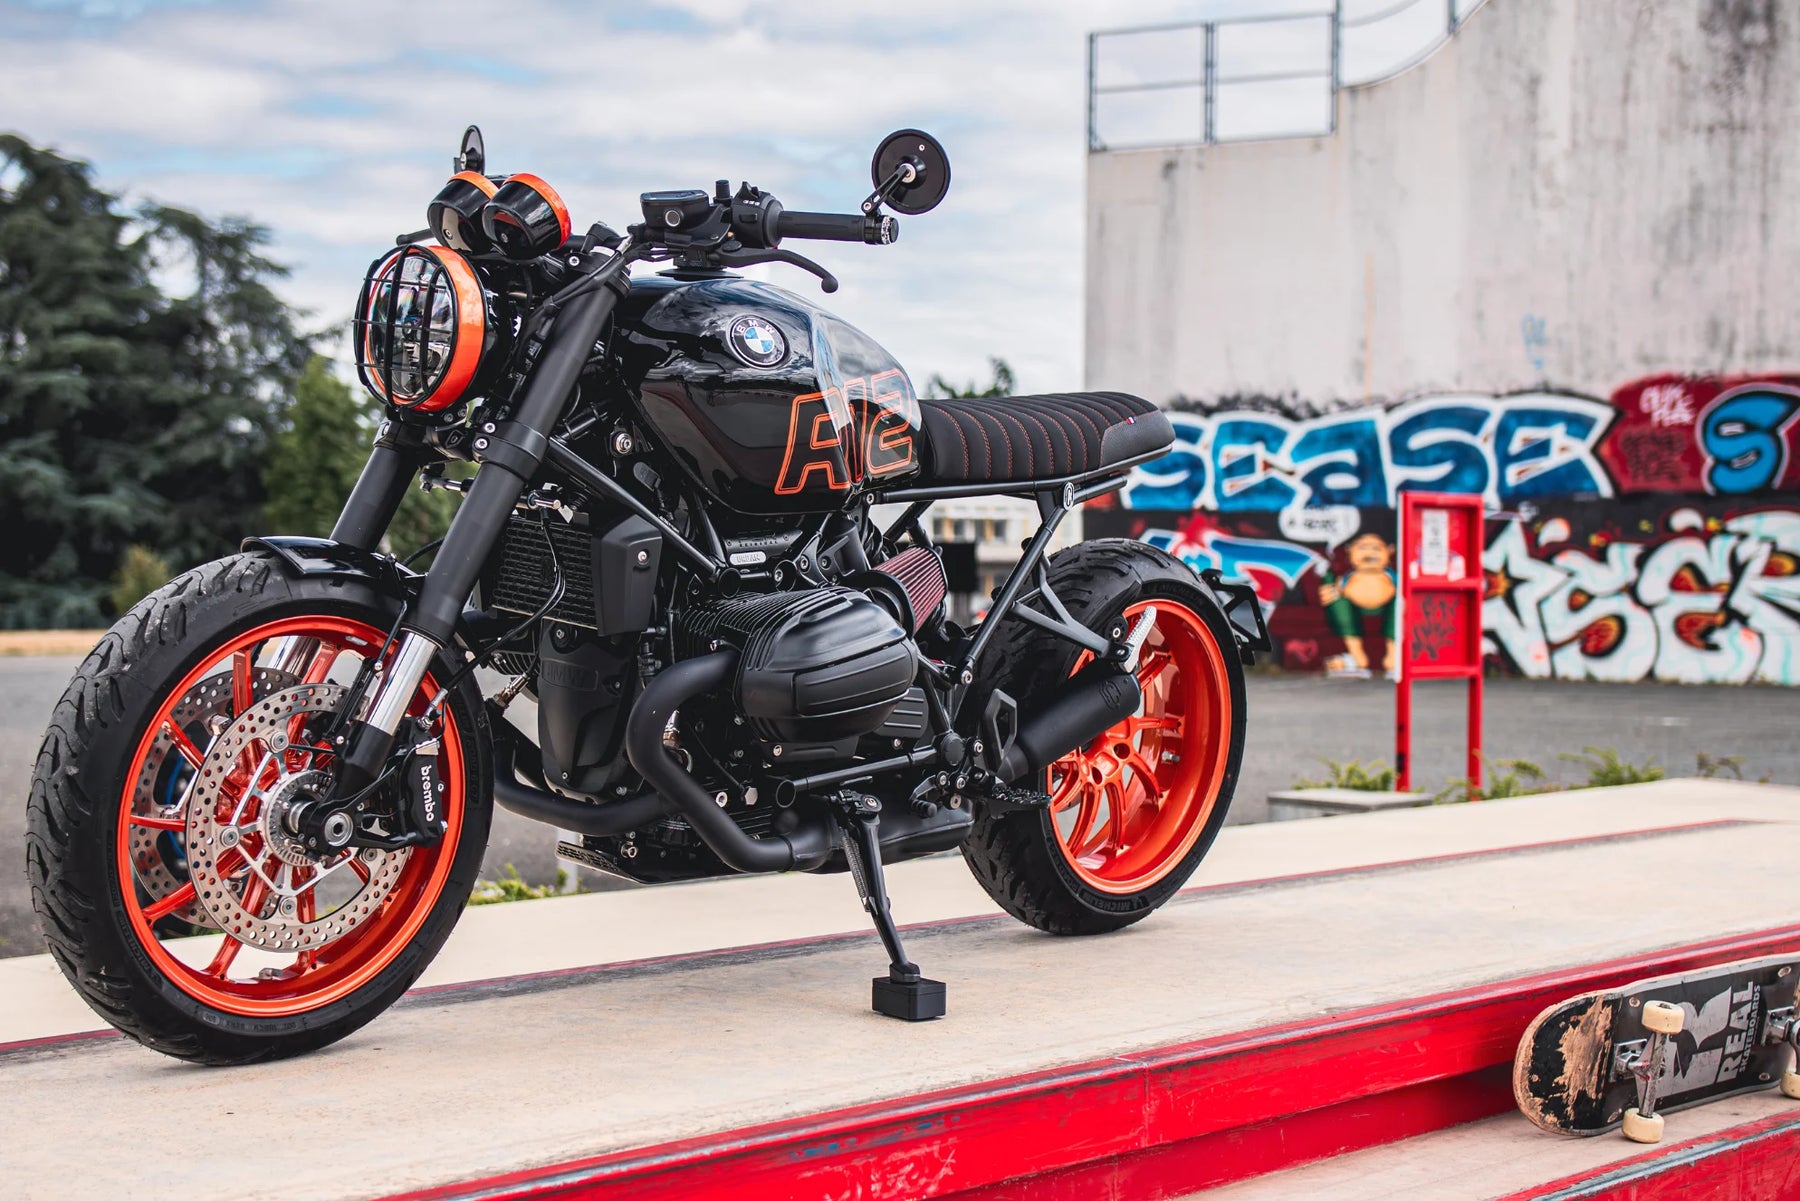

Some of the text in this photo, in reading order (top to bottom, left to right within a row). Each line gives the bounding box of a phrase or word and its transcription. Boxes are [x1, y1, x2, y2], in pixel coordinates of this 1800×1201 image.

[736, 319, 774, 333] BMW
[421, 765, 436, 822] brembo
[1716, 981, 1753, 1083] REAL
[1739, 985, 1760, 1072] SKATEBOARDS
